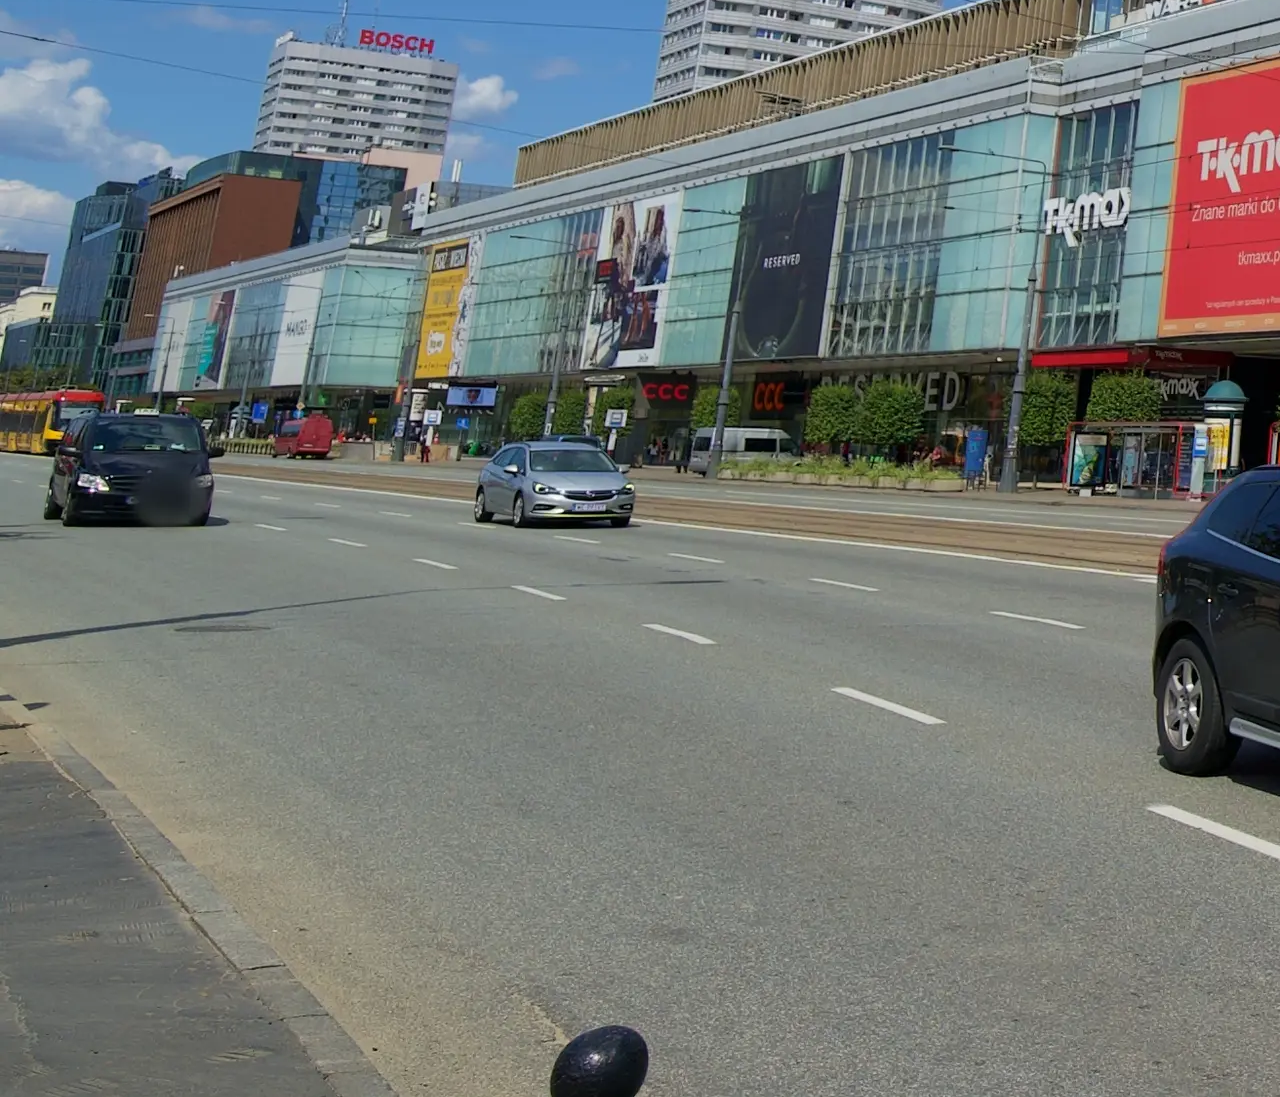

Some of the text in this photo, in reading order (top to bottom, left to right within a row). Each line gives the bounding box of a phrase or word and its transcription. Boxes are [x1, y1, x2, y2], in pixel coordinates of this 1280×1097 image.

[359, 29, 435, 54] BOSCH
[1192, 205, 1225, 222] Znane
[1227, 197, 1258, 217] marki
[1260, 196, 1276, 213] do
[763, 253, 800, 269] RESERVED
[642, 383, 690, 400] CCC
[754, 382, 785, 411] CCC
